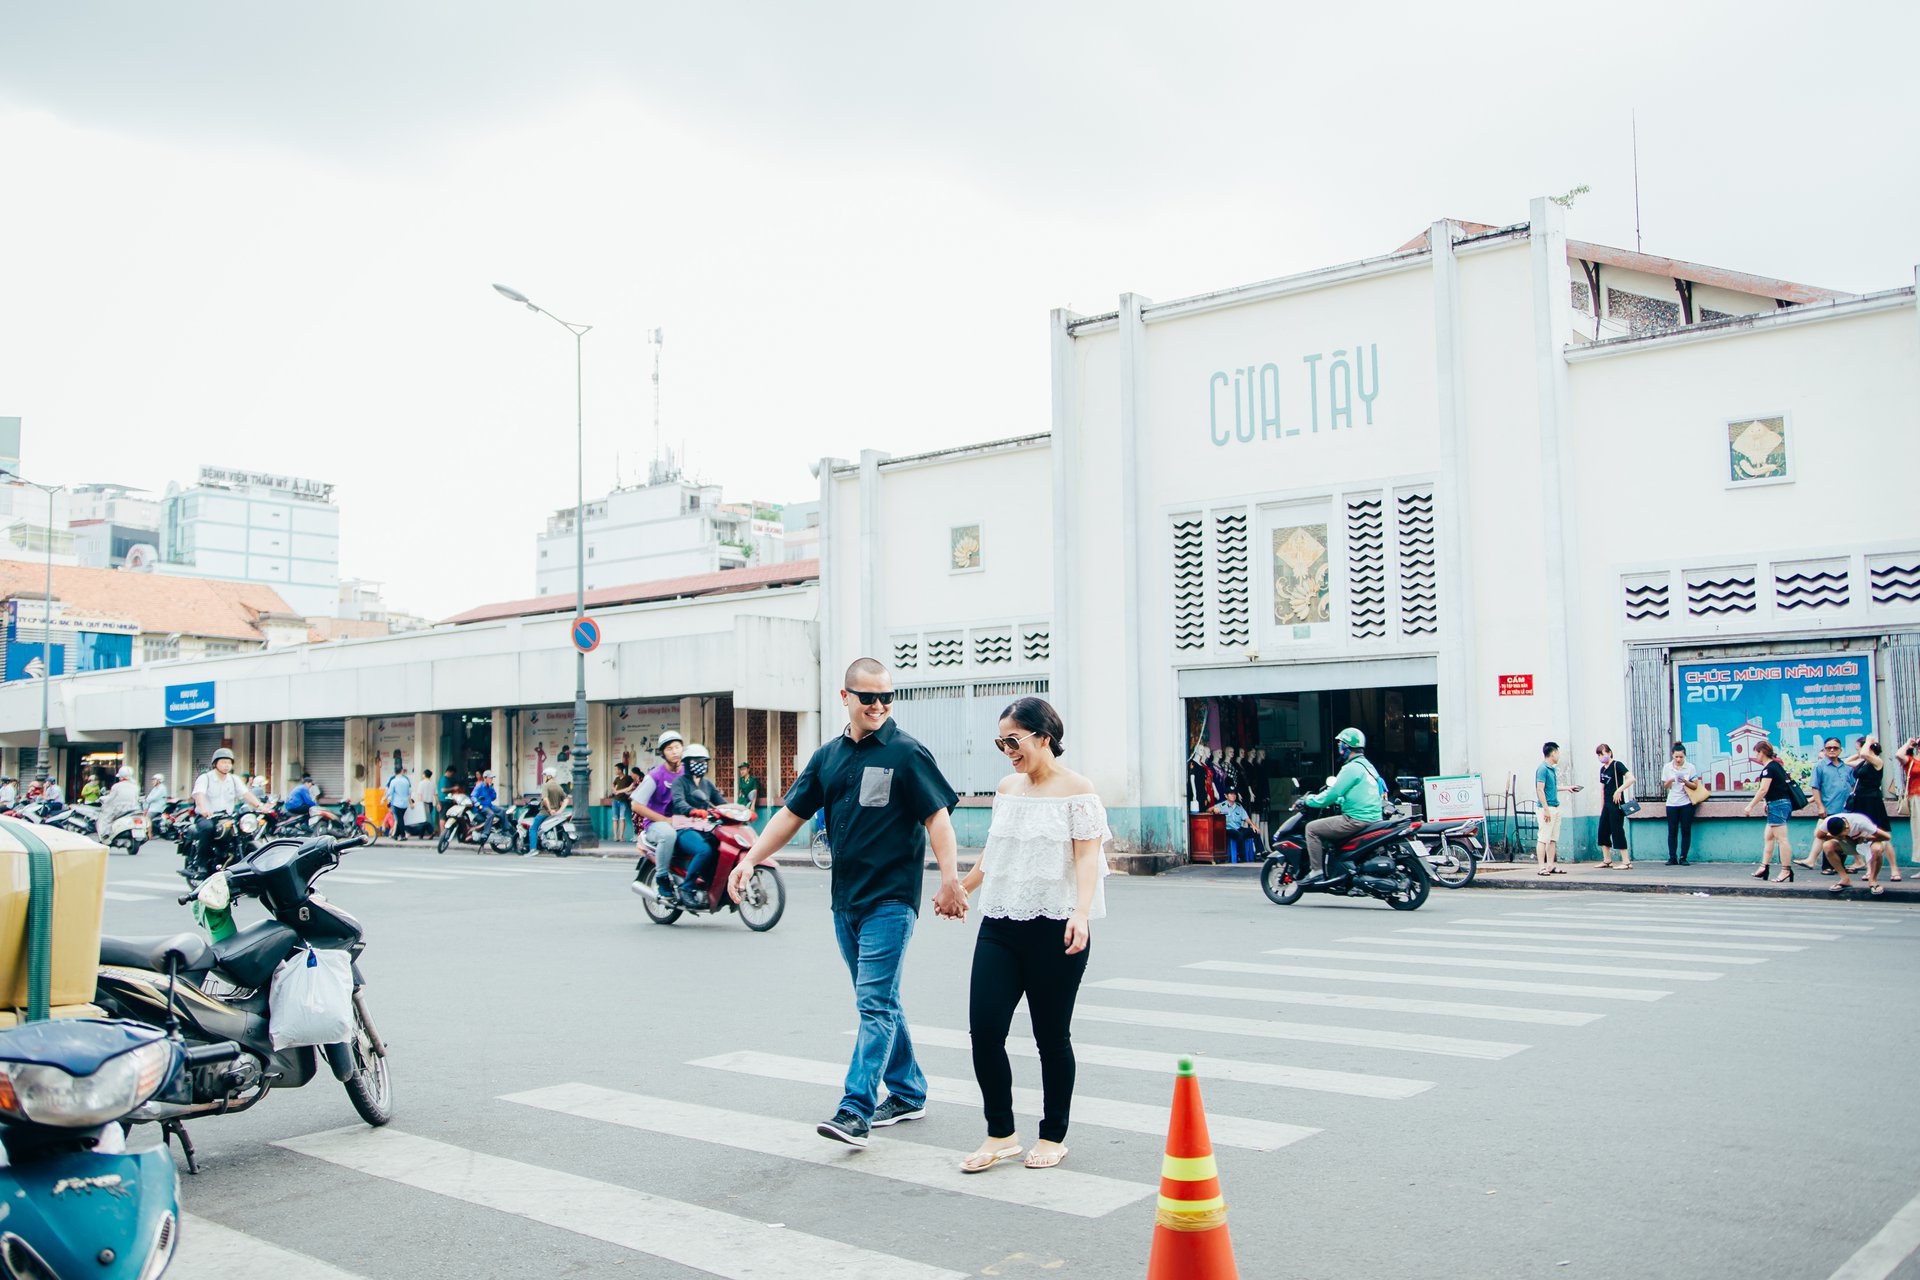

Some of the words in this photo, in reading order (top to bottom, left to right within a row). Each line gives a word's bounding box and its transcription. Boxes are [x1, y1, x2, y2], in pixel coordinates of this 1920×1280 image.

[1685, 668, 1732, 684] CHÚC
[1734, 666, 1783, 682] MỪNG
[1785, 663, 1824, 679] NĂM
[1826, 660, 1859, 677] MỚI
[1686, 684, 1744, 703] 2017
